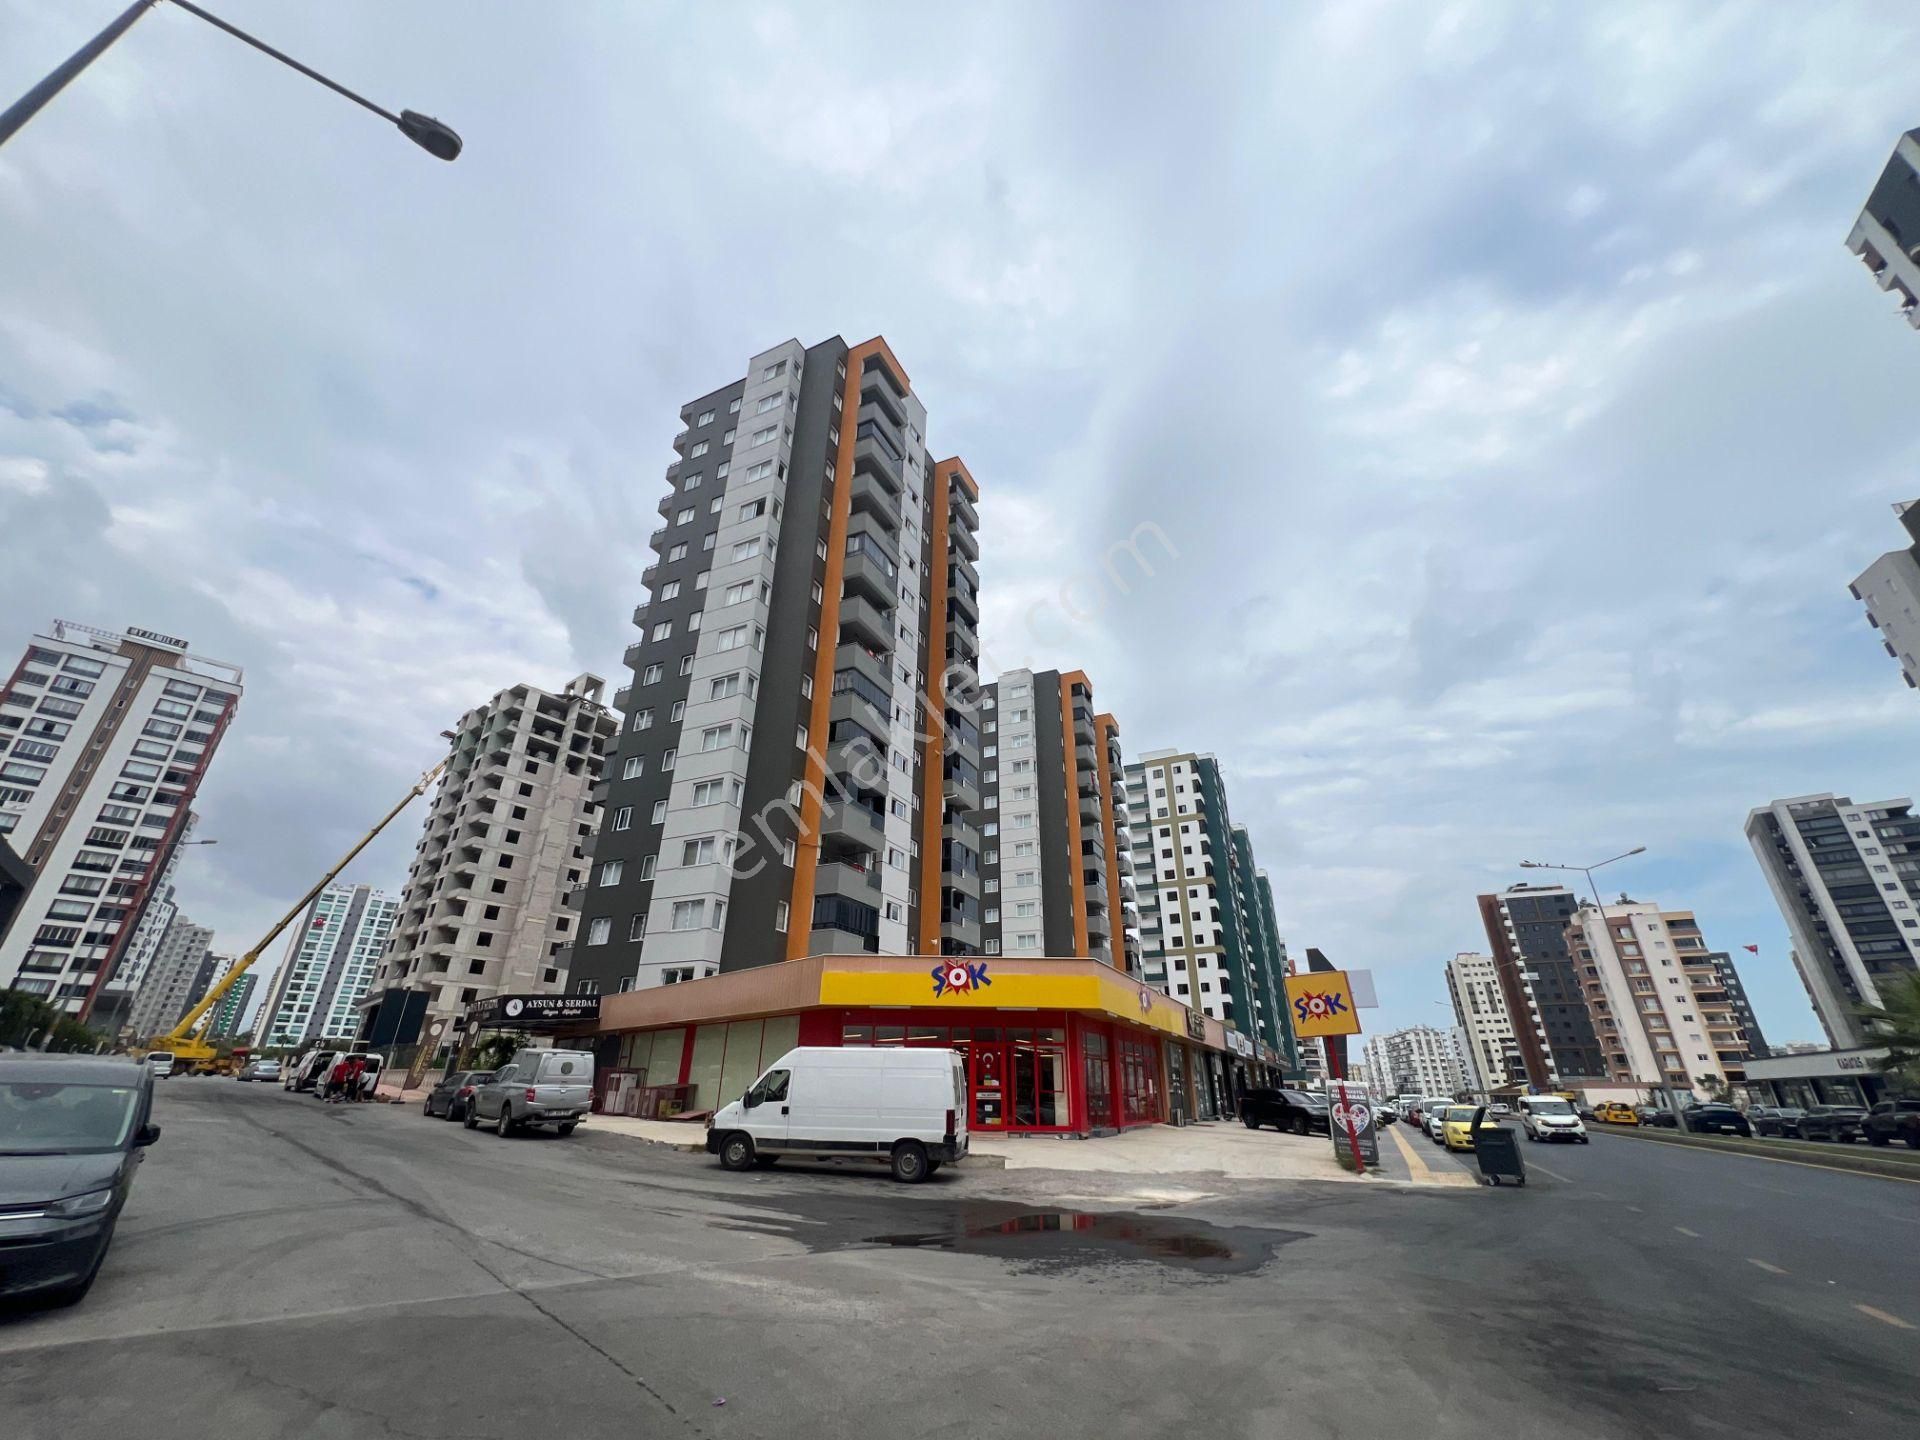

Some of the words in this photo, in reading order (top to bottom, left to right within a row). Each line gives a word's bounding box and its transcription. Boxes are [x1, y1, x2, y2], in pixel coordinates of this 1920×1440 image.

[931, 962, 992, 999] ŞOK
[526, 999, 555, 1009] AYSUN
[556, 999, 564, 1008] &
[564, 999, 598, 1008] SERDAL
[1294, 992, 1348, 1024] ŞOK
